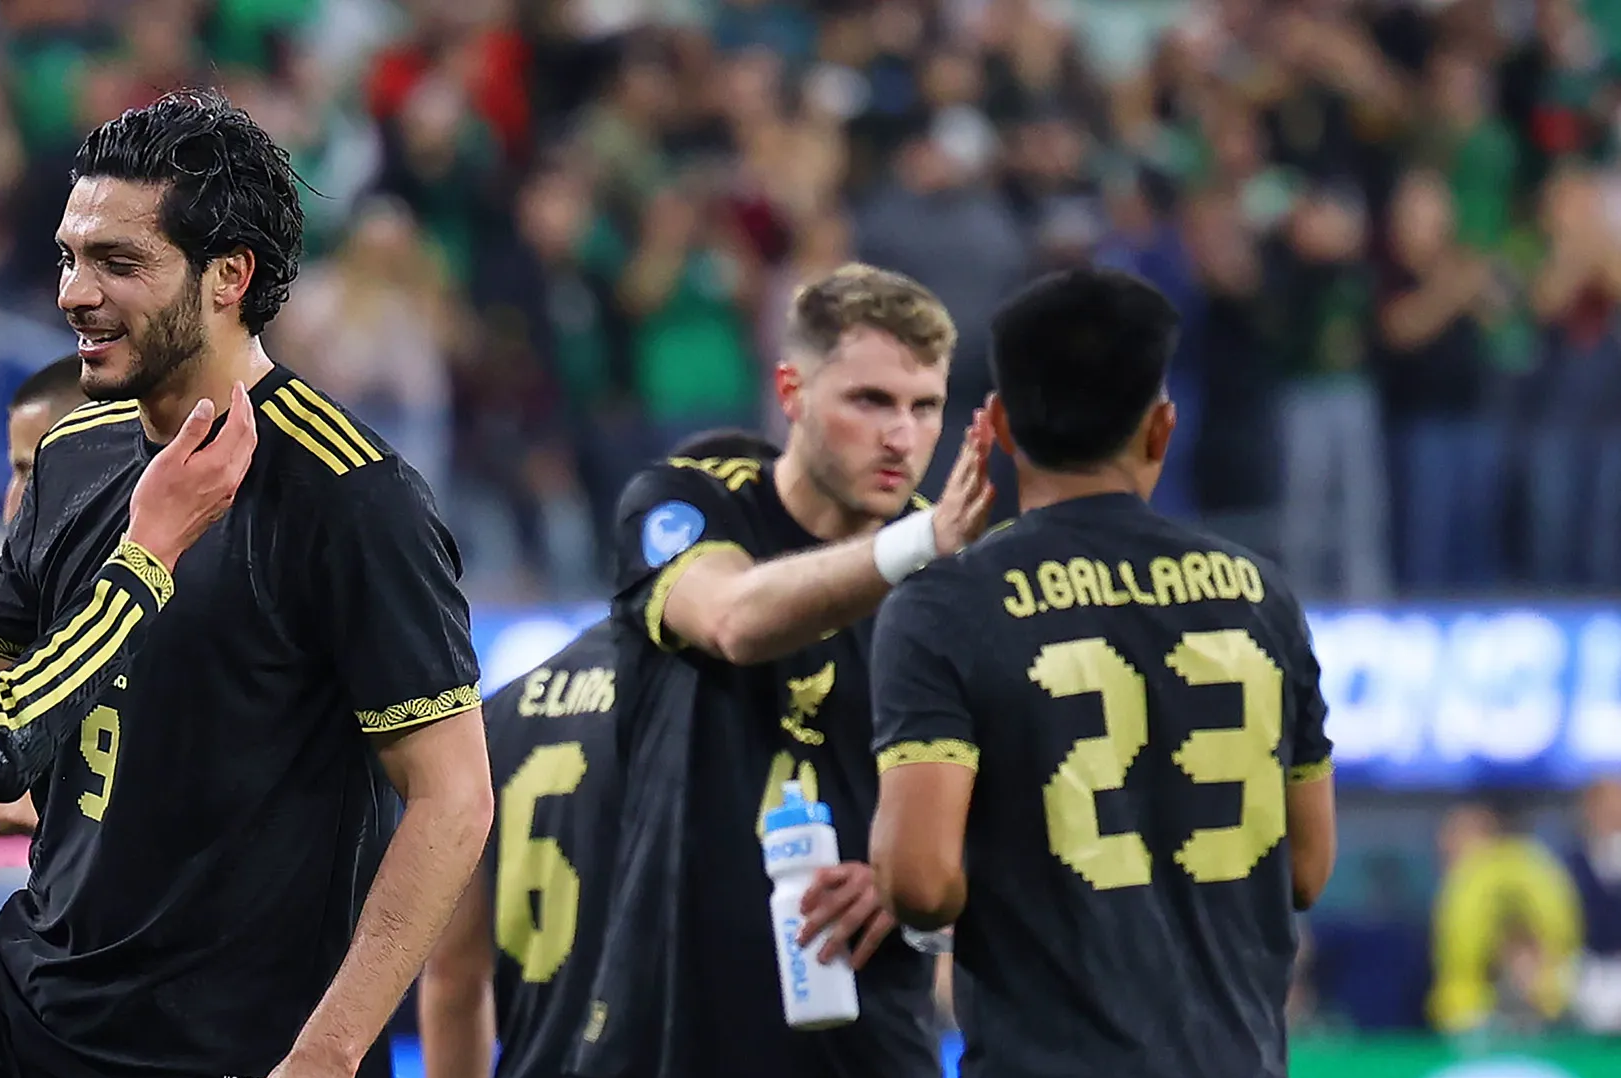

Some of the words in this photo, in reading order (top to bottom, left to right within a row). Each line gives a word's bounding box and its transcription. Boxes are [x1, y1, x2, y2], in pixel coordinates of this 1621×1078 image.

[1003, 551, 1265, 618] J.GALLARDO
[77, 704, 120, 822] 9
[1027, 628, 1287, 891] 23
[495, 741, 587, 984] 6
